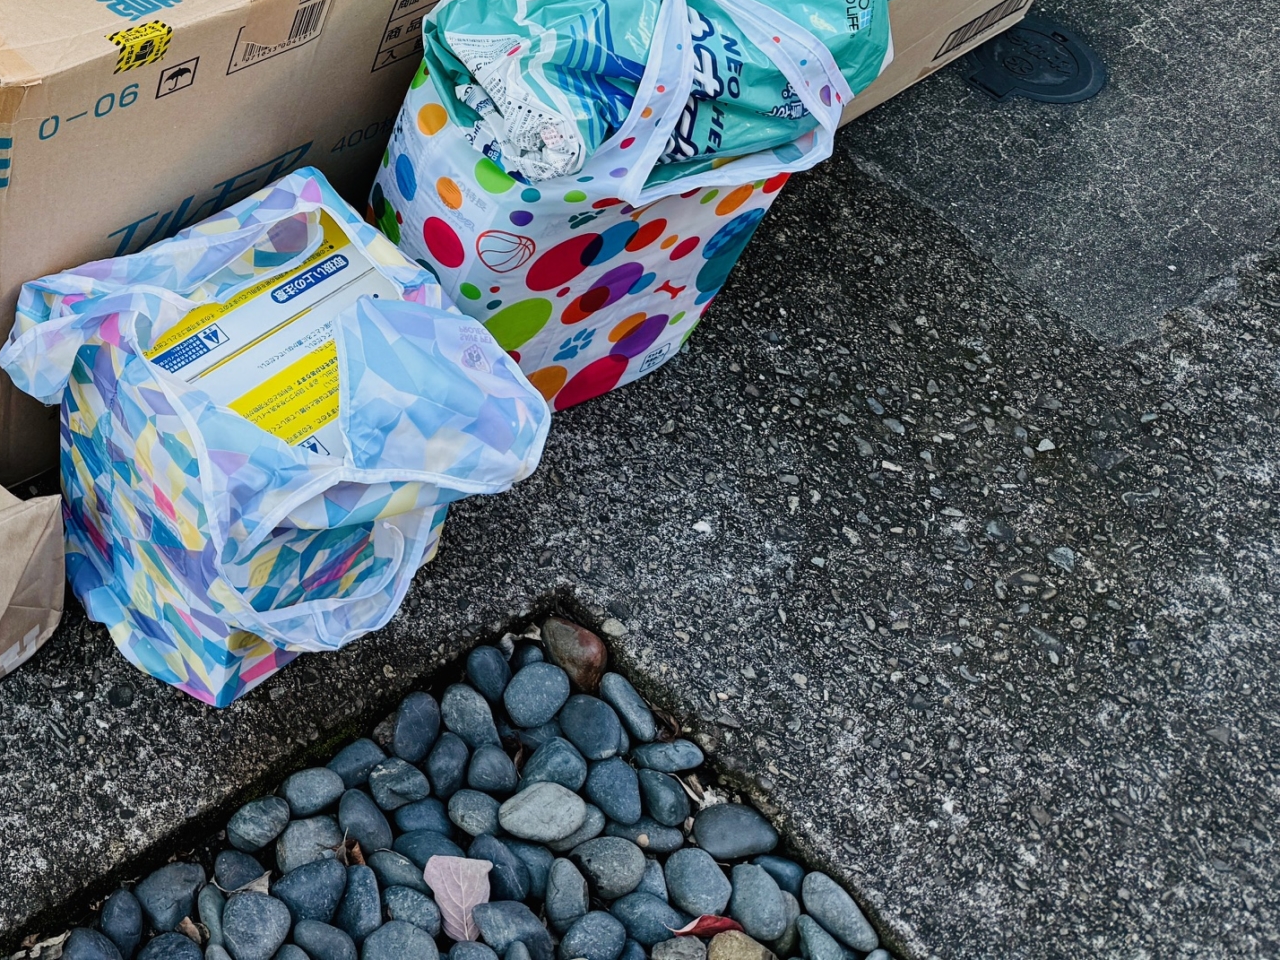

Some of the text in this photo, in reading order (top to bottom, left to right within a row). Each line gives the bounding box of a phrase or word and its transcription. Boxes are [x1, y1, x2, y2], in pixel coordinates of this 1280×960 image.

[720, 33, 745, 100] NEO
[273, 254, 347, 303] 取扱い上の注意
